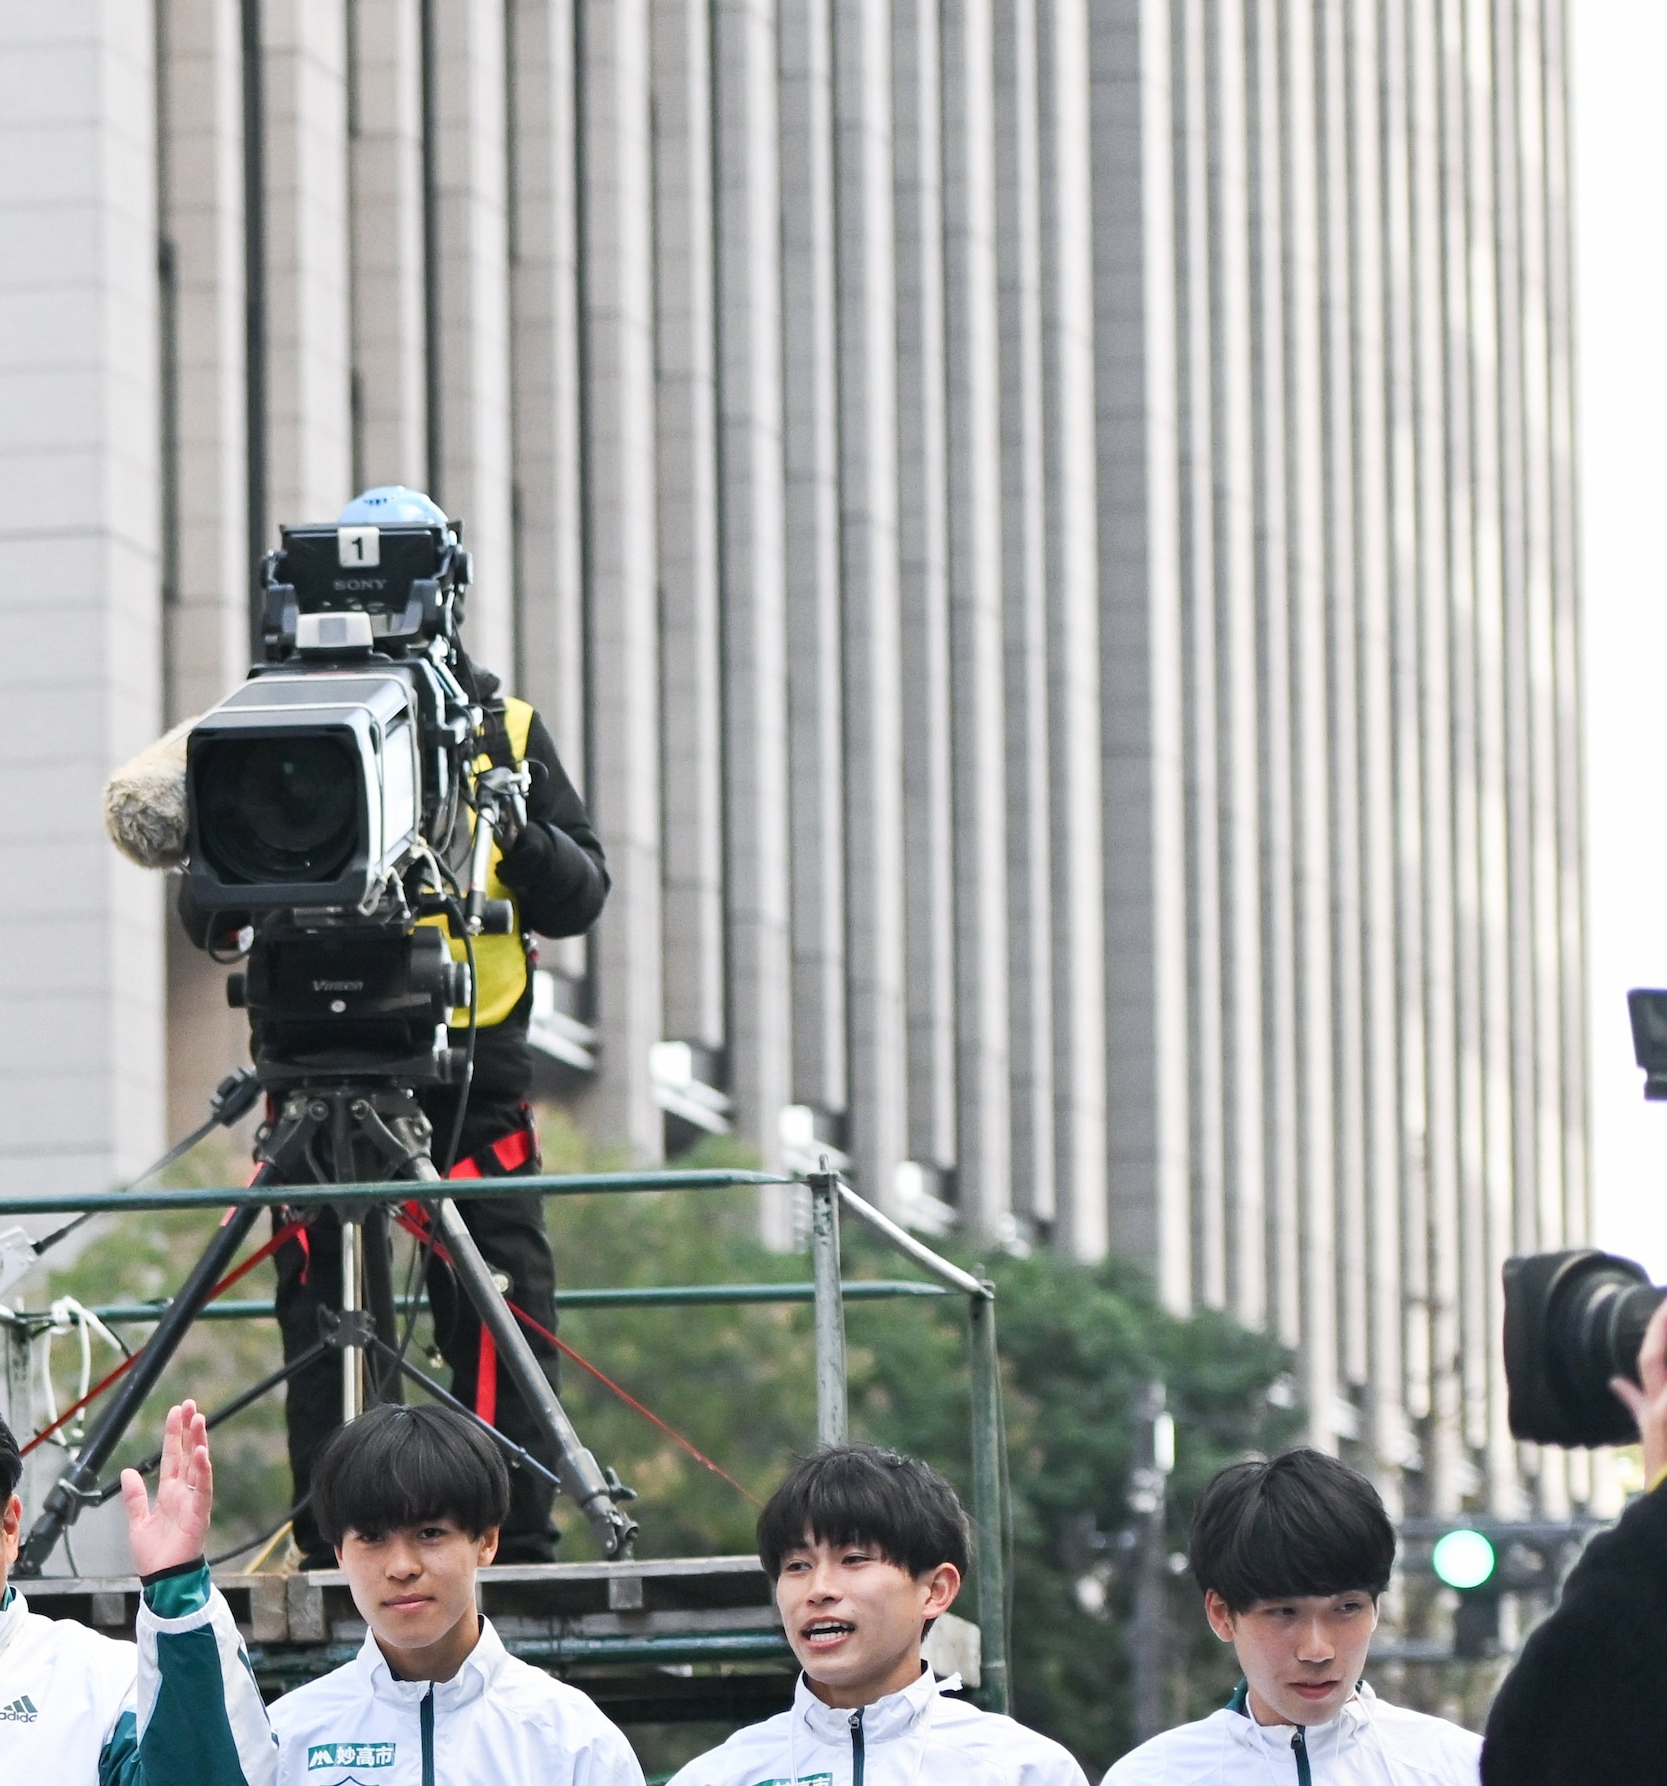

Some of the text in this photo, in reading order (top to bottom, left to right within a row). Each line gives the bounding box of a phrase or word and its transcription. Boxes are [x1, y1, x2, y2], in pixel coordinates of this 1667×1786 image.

[352, 537, 363, 560] 1
[334, 579, 387, 591] SONY
[336, 1746, 393, 1766] 妙高市
